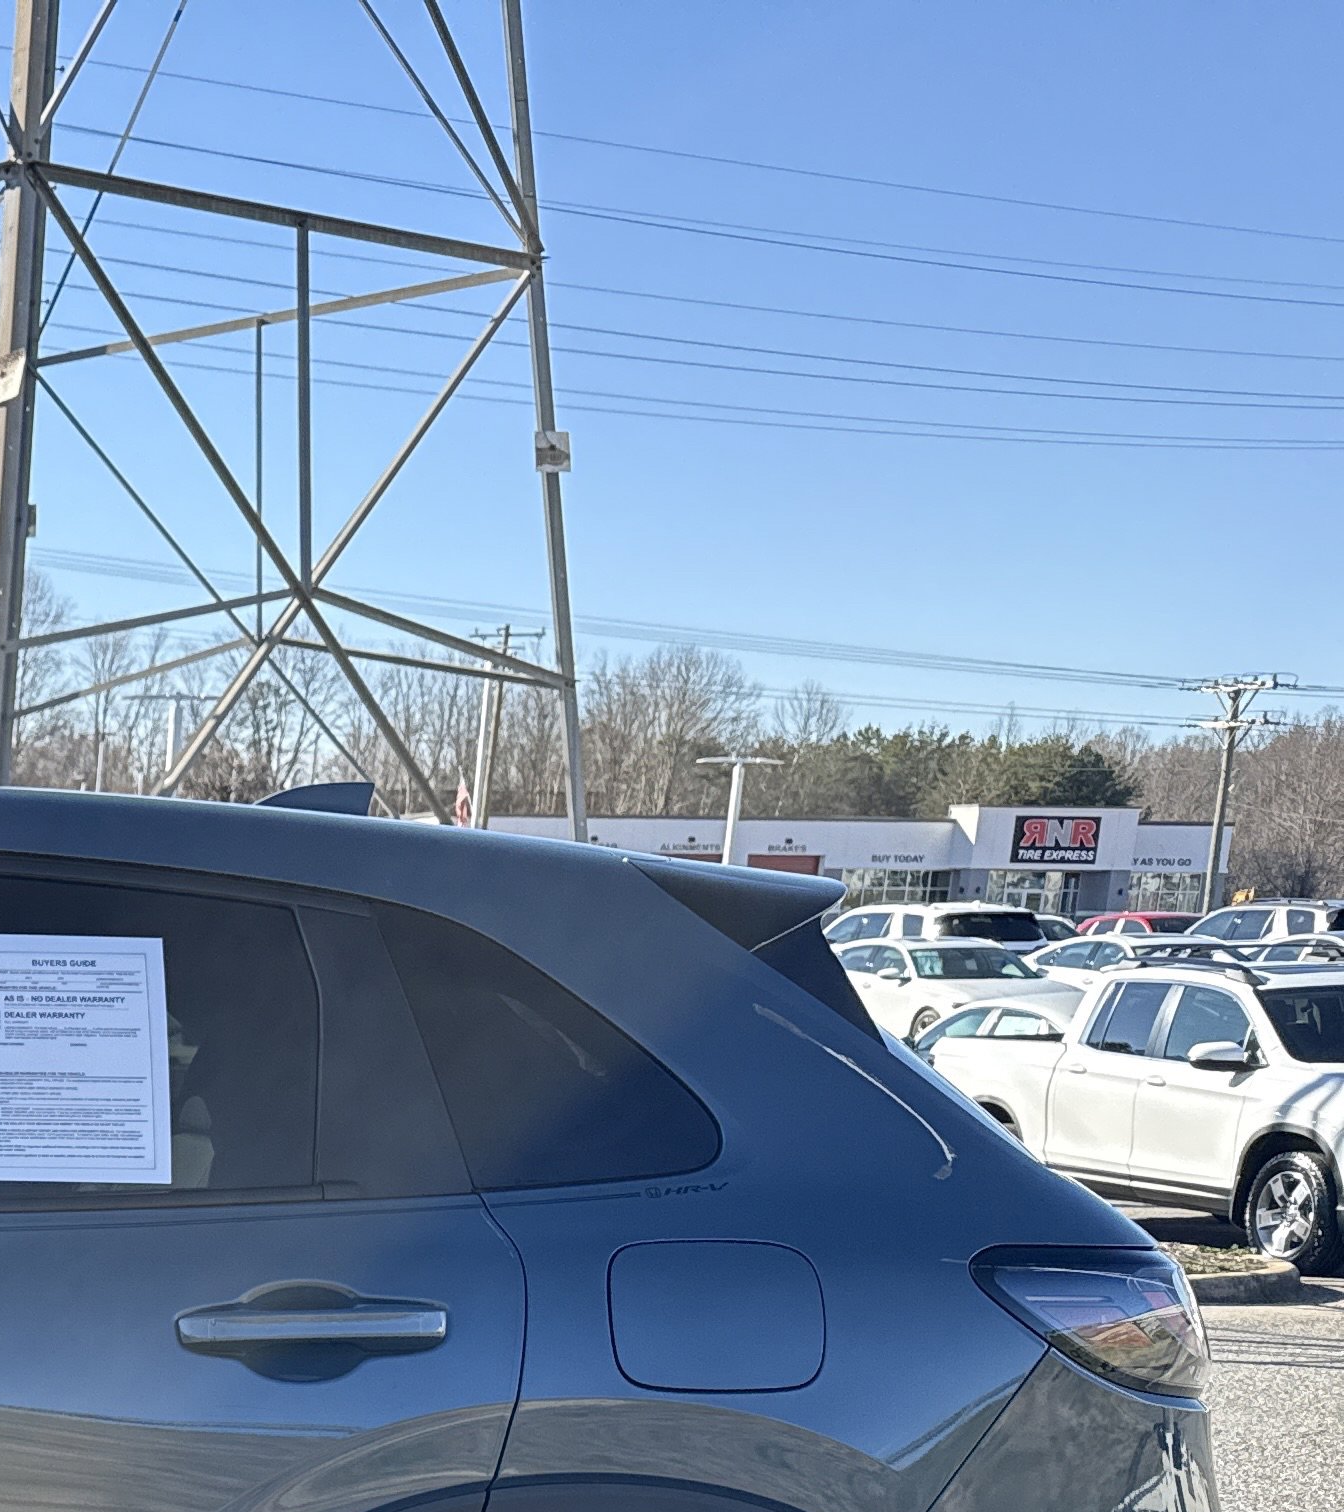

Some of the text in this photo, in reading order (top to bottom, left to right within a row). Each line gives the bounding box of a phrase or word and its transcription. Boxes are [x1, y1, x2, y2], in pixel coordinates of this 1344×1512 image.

[659, 842, 721, 851] ALIGNMENTS
[767, 844, 807, 853] BRAKES
[871, 854, 925, 863] BUY TODAY
[1017, 849, 1095, 861] TIRE EXPRESS
[1139, 857, 1153, 866] AS
[1155, 857, 1175, 866] YOU
[1177, 857, 1192, 866] GO
[31, 959, 96, 968] BUYERS GUIDE
[30, 995, 43, 1003] NO
[79, 996, 126, 1004] WARRANTY
[4, 1011, 37, 1019] DEALER
[663, 1182, 729, 1196] HR-V
